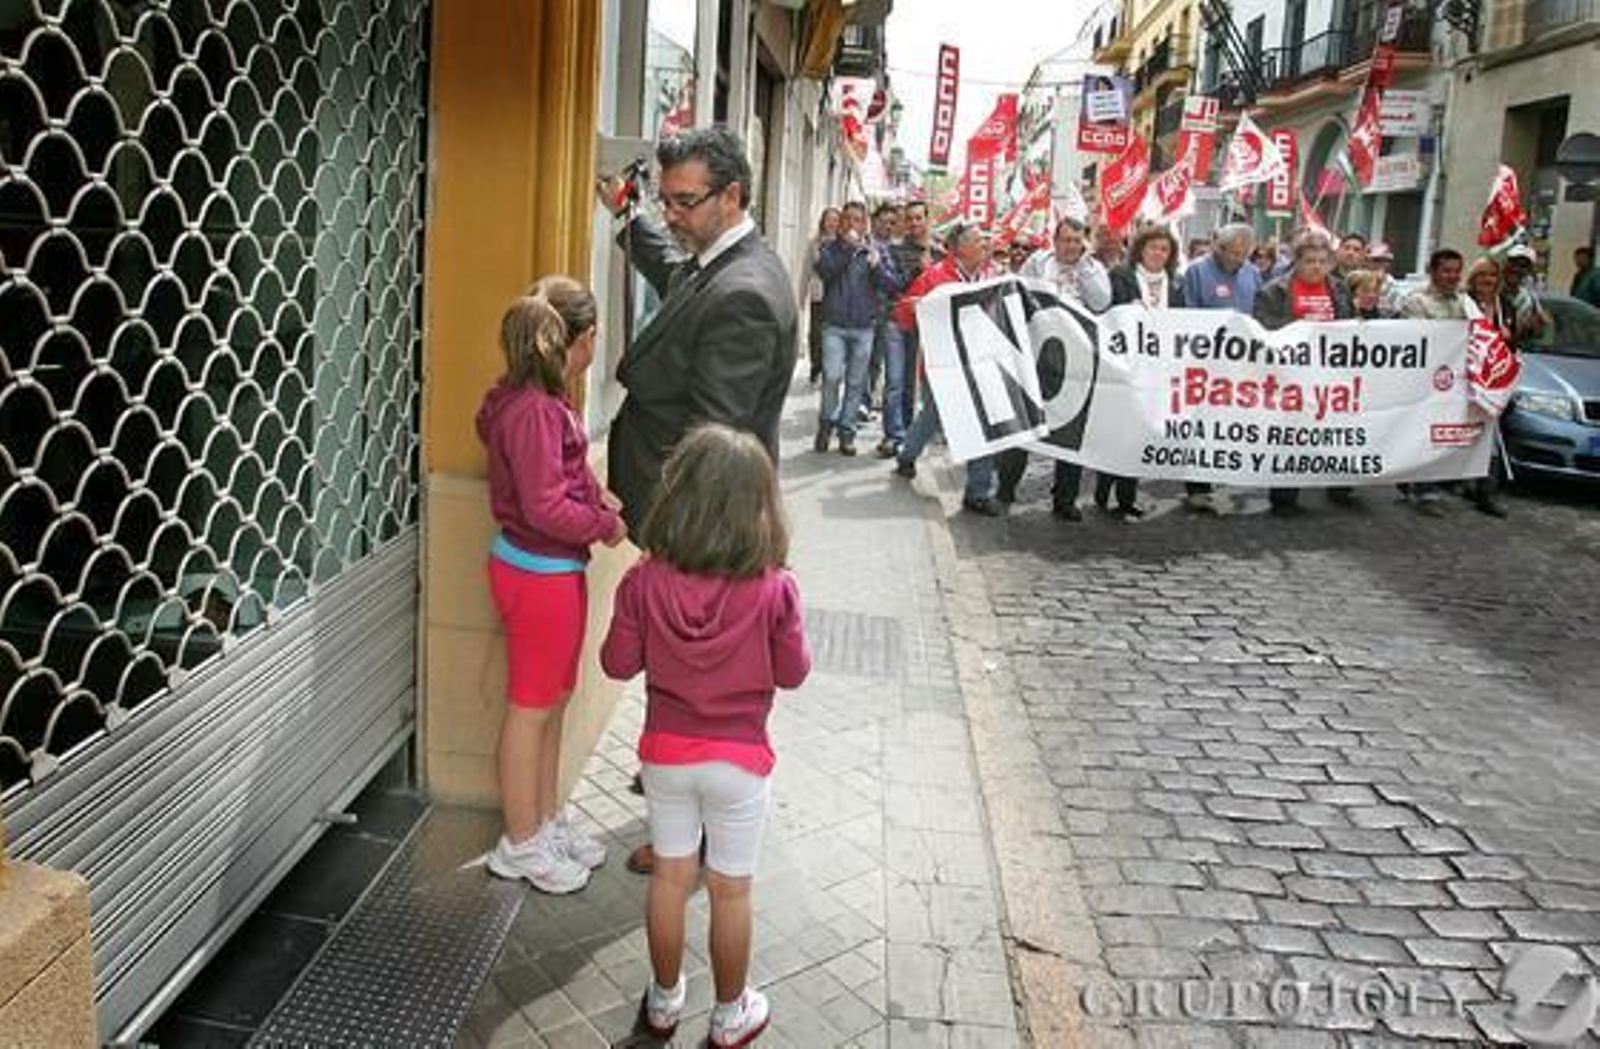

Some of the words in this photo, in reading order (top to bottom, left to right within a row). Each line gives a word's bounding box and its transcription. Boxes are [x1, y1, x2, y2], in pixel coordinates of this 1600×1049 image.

[933, 50, 957, 155] CCOO
[957, 292, 1095, 433] NO
[1108, 330, 1128, 354] a
[1138, 321, 1160, 357] la
[1174, 325, 1311, 366] reforma
[1320, 335, 1429, 369] laboral
[1170, 366, 1304, 414] ¡Basta
[1315, 376, 1363, 421] ya!
[1213, 421, 1260, 443] LOS
[1267, 426, 1366, 447] RECORTES
[1141, 445, 1242, 471] SOCIALES
[1250, 453, 1265, 472] Y
[1272, 454, 1383, 475] LABORALES
